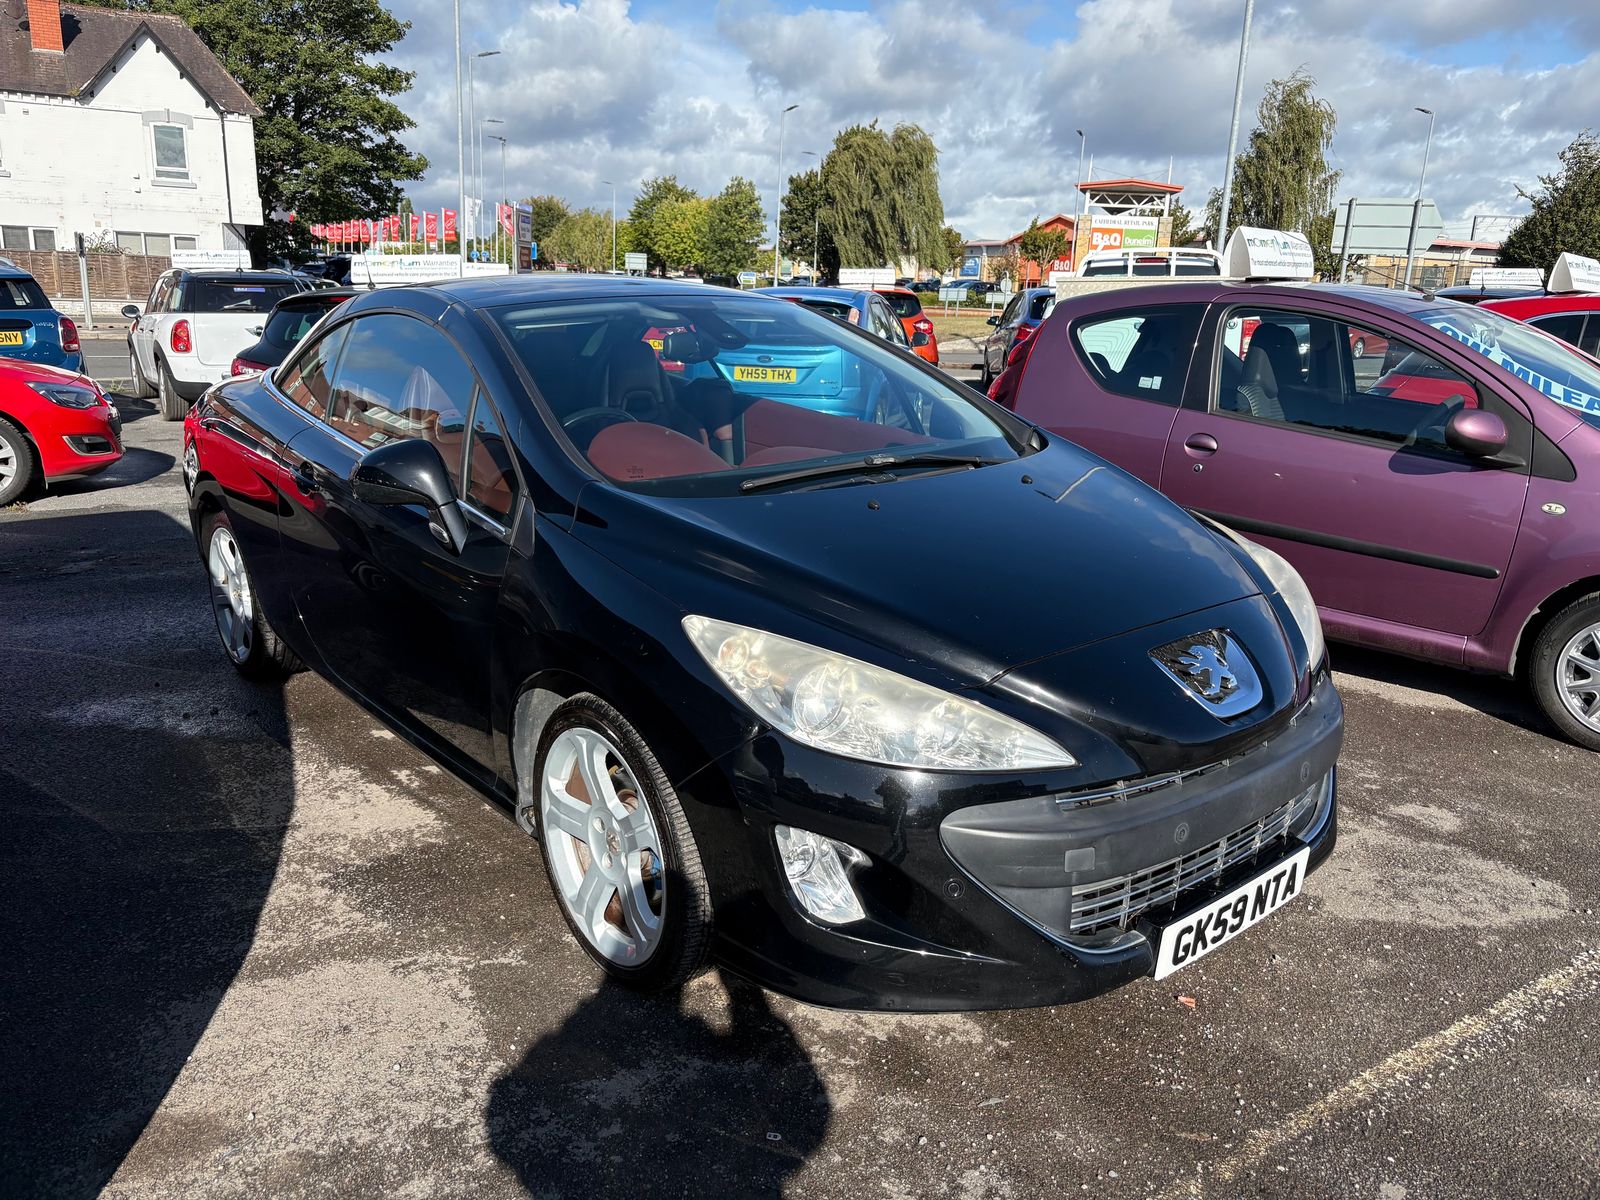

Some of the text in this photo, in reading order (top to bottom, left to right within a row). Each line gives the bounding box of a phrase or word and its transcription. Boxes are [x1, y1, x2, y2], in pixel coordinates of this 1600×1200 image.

[1092, 232, 1122, 246] B&Q
[1054, 260, 1070, 270] B&Q
[739, 367, 792, 381] YH59 THX
[1172, 862, 1298, 966] GK59 NTA
